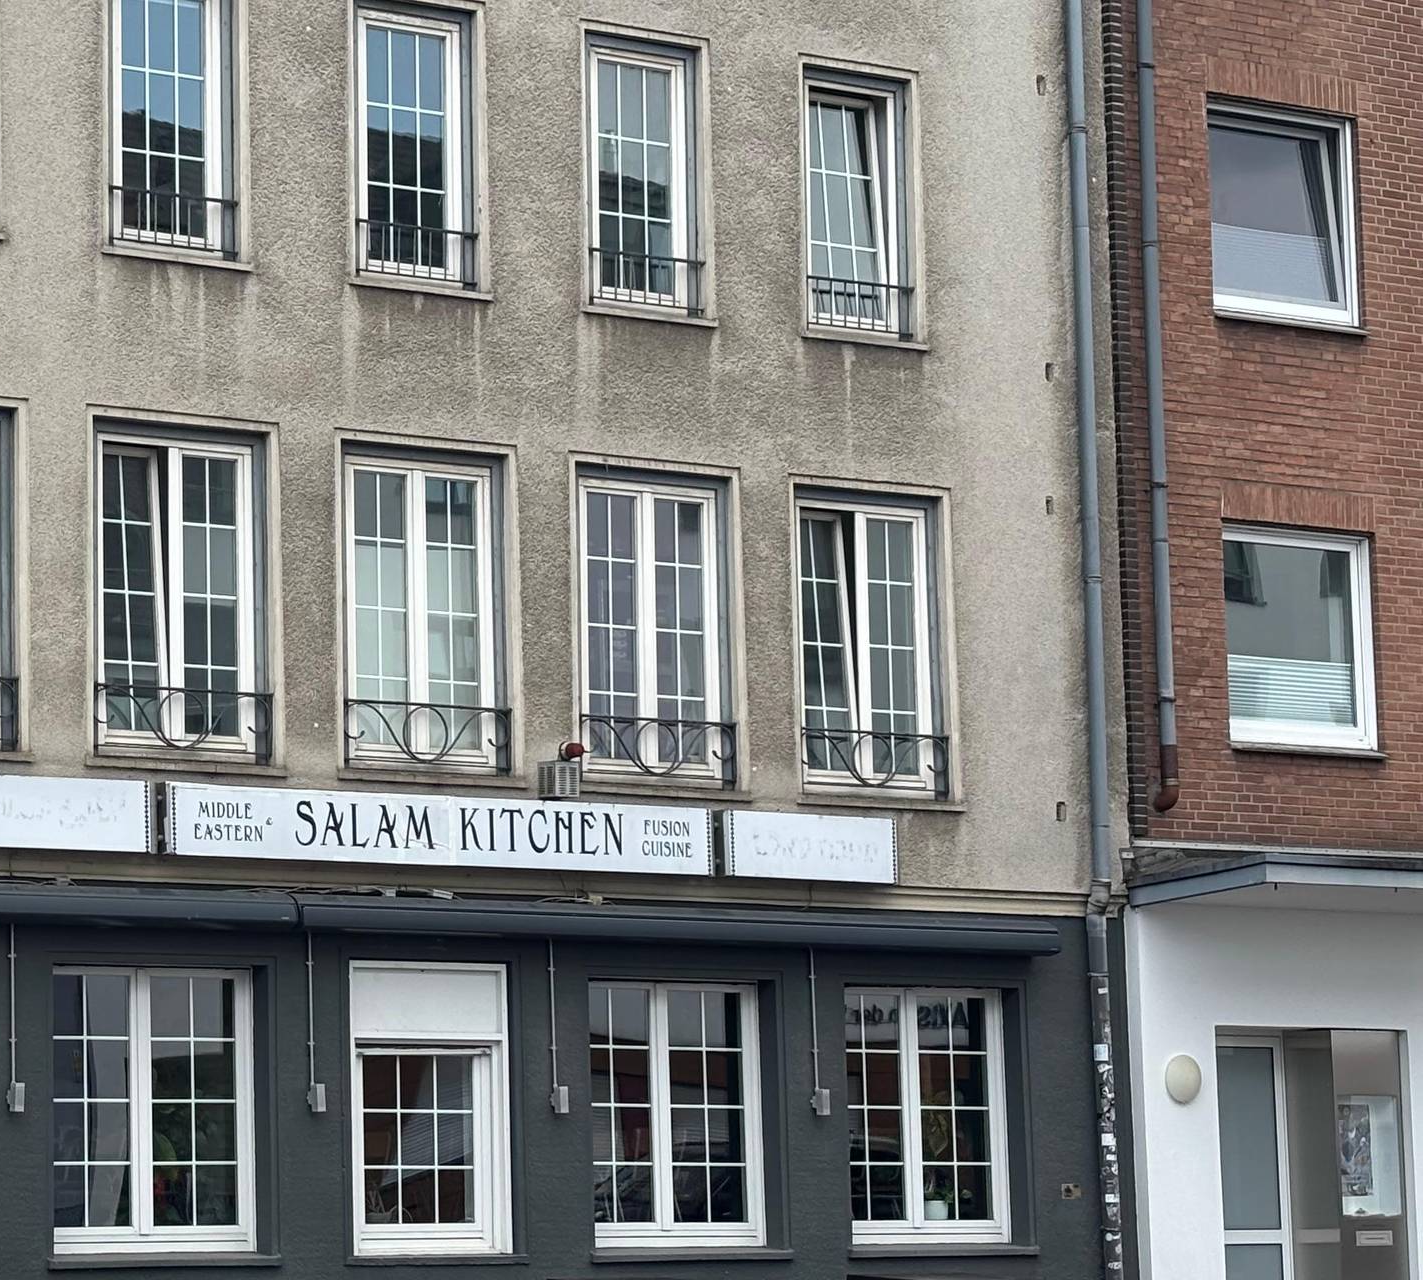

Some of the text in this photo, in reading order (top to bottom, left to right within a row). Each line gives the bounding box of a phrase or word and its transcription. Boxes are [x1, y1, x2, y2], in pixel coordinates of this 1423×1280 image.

[198, 801, 253, 820] MIDDLE
[194, 816, 274, 842] EASTERN &
[295, 800, 624, 856] SALAM KITCHEN
[644, 819, 690, 837] FUSION
[642, 840, 694, 858] CUISINE
